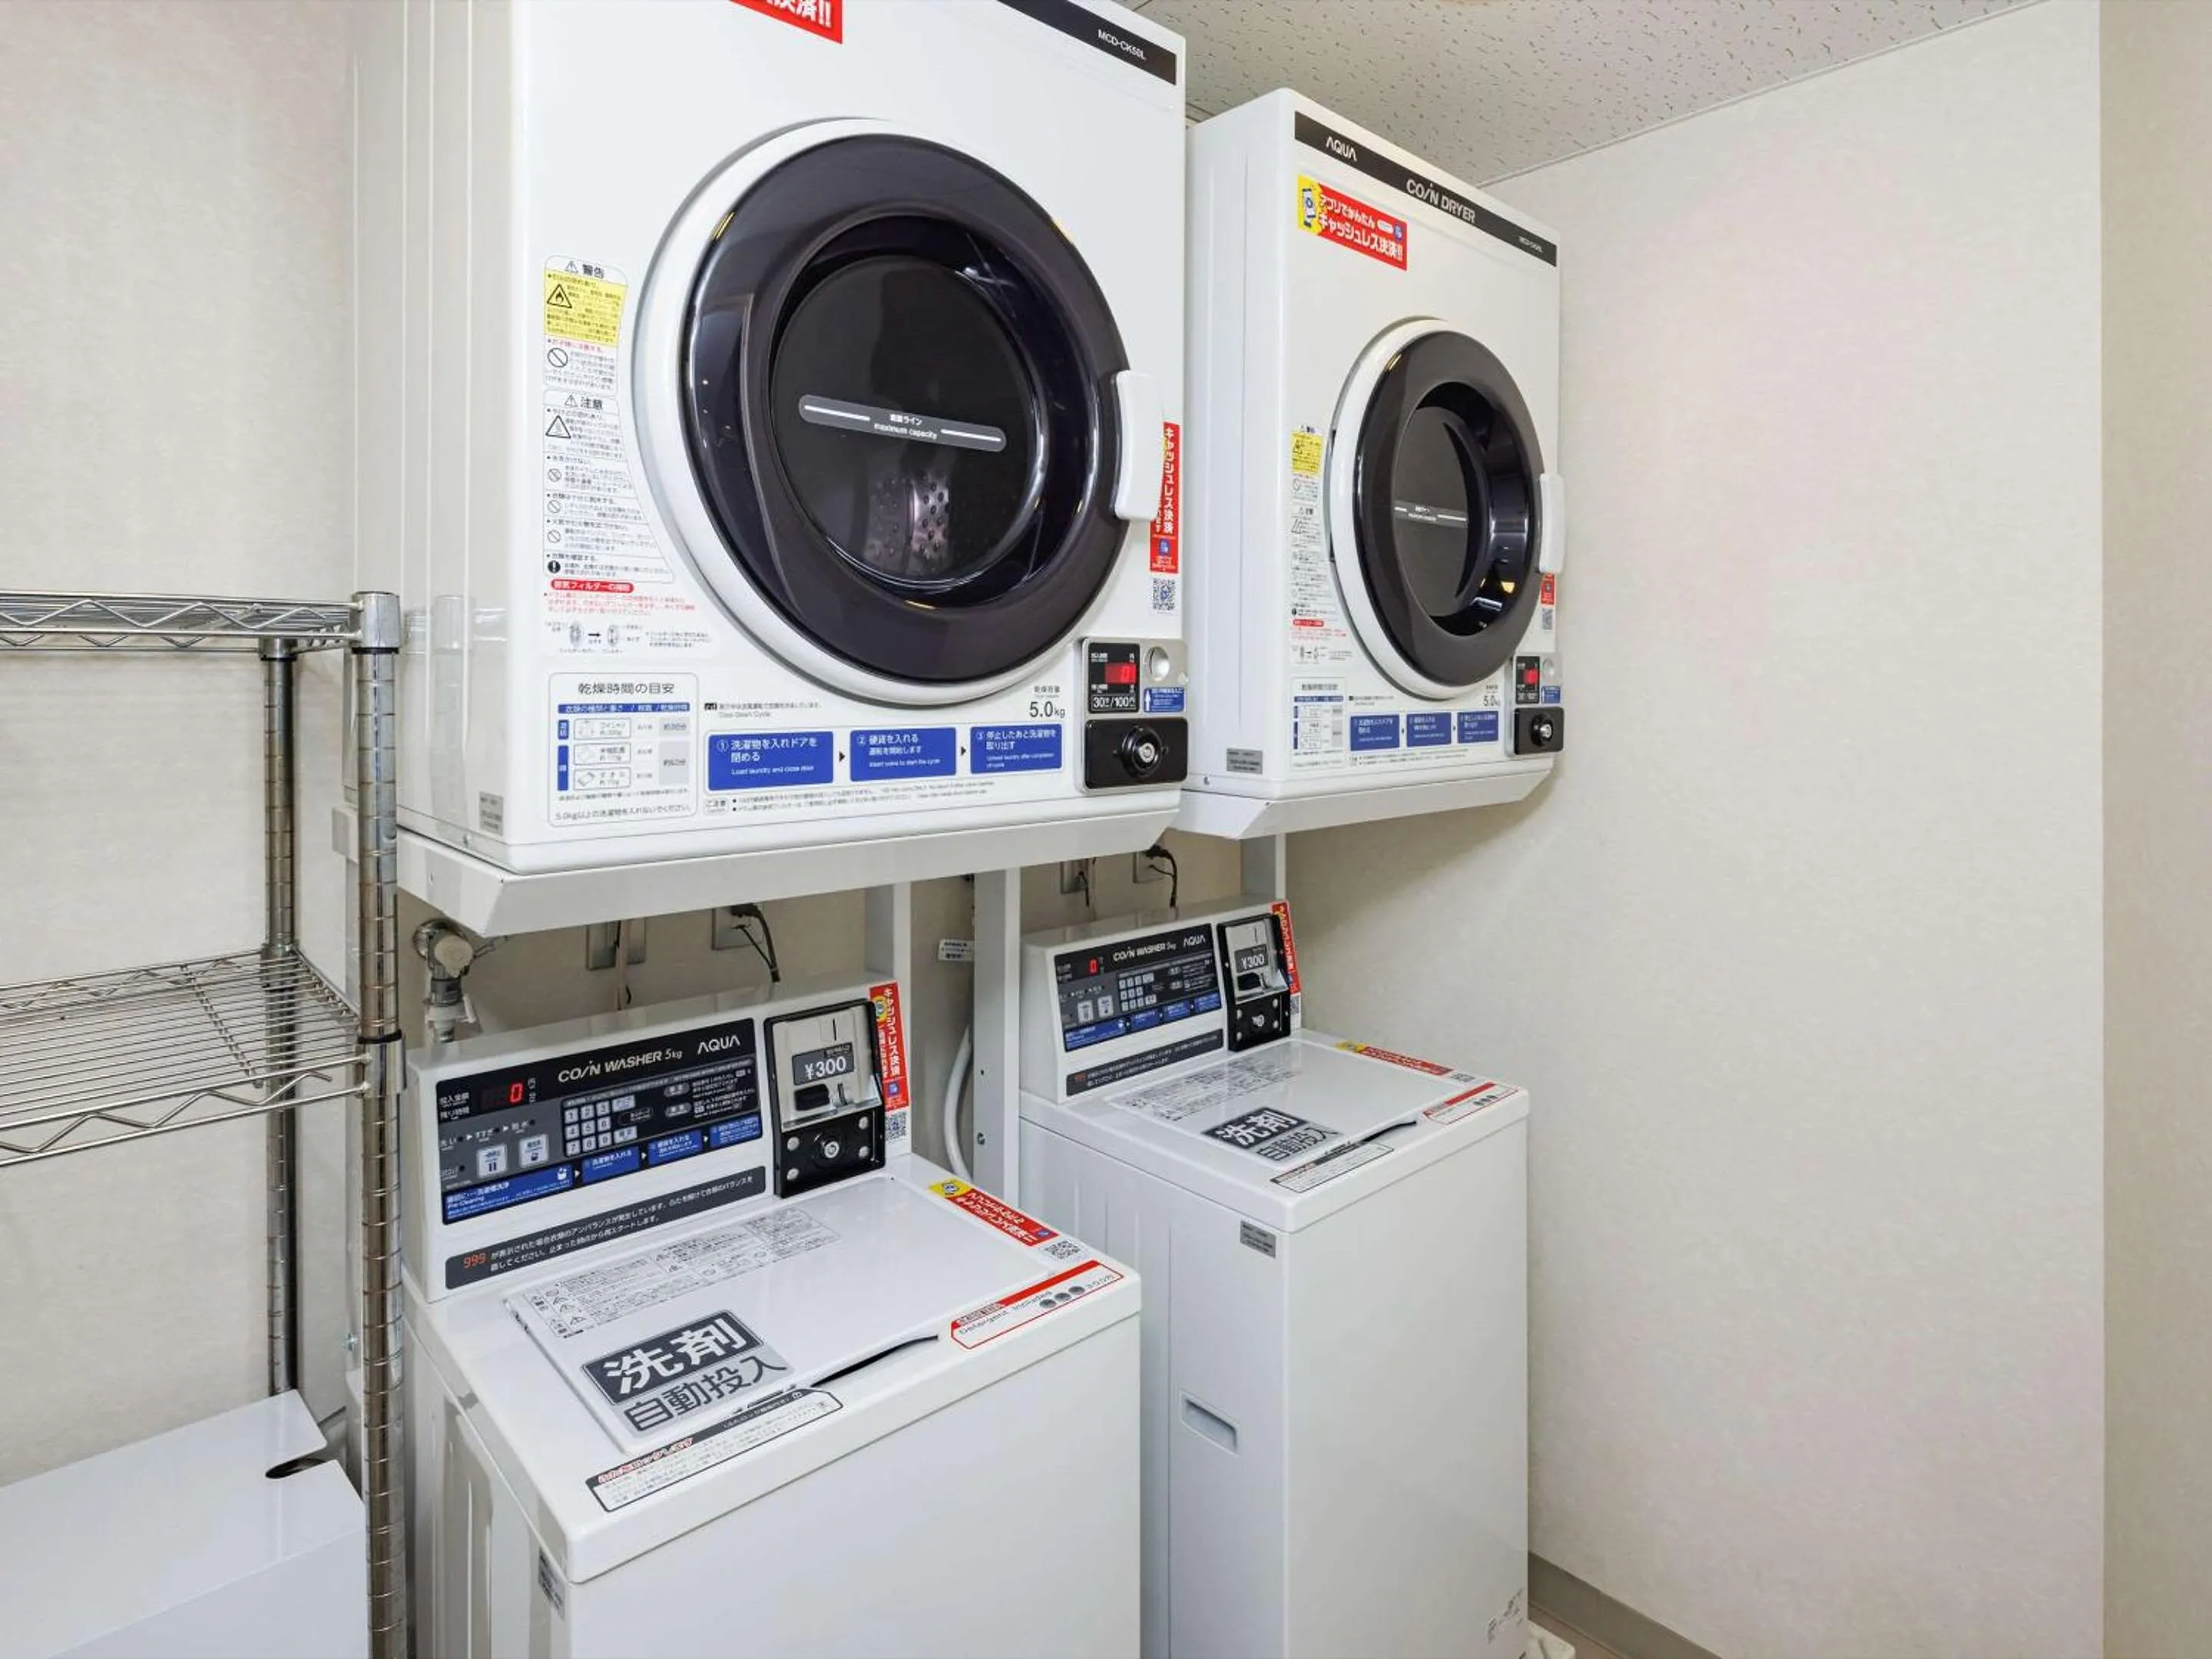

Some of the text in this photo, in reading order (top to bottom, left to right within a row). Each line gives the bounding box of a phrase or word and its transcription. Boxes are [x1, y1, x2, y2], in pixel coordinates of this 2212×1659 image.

[1326, 136, 1357, 162] AQUA
[1441, 197, 1475, 224] DRYER
[578, 682, 675, 695] 乾燥時間の目安
[731, 737, 818, 751] 洗濯物を入れドアを
[731, 752, 760, 763] 閉める
[1184, 934, 1206, 948] AQUA
[1241, 953, 1265, 969] ¥300
[697, 1035, 740, 1055] AQUA
[604, 1051, 661, 1073] WASHER
[665, 1048, 684, 1060] 5kg
[805, 1057, 846, 1080] ¥300
[510, 1083, 523, 1103] 0
[1215, 1110, 1298, 1146] 洗剤
[1257, 1128, 1339, 1161] 自動投入
[604, 1317, 748, 1395] 洗剤
[624, 1356, 788, 1432] 自動投入
